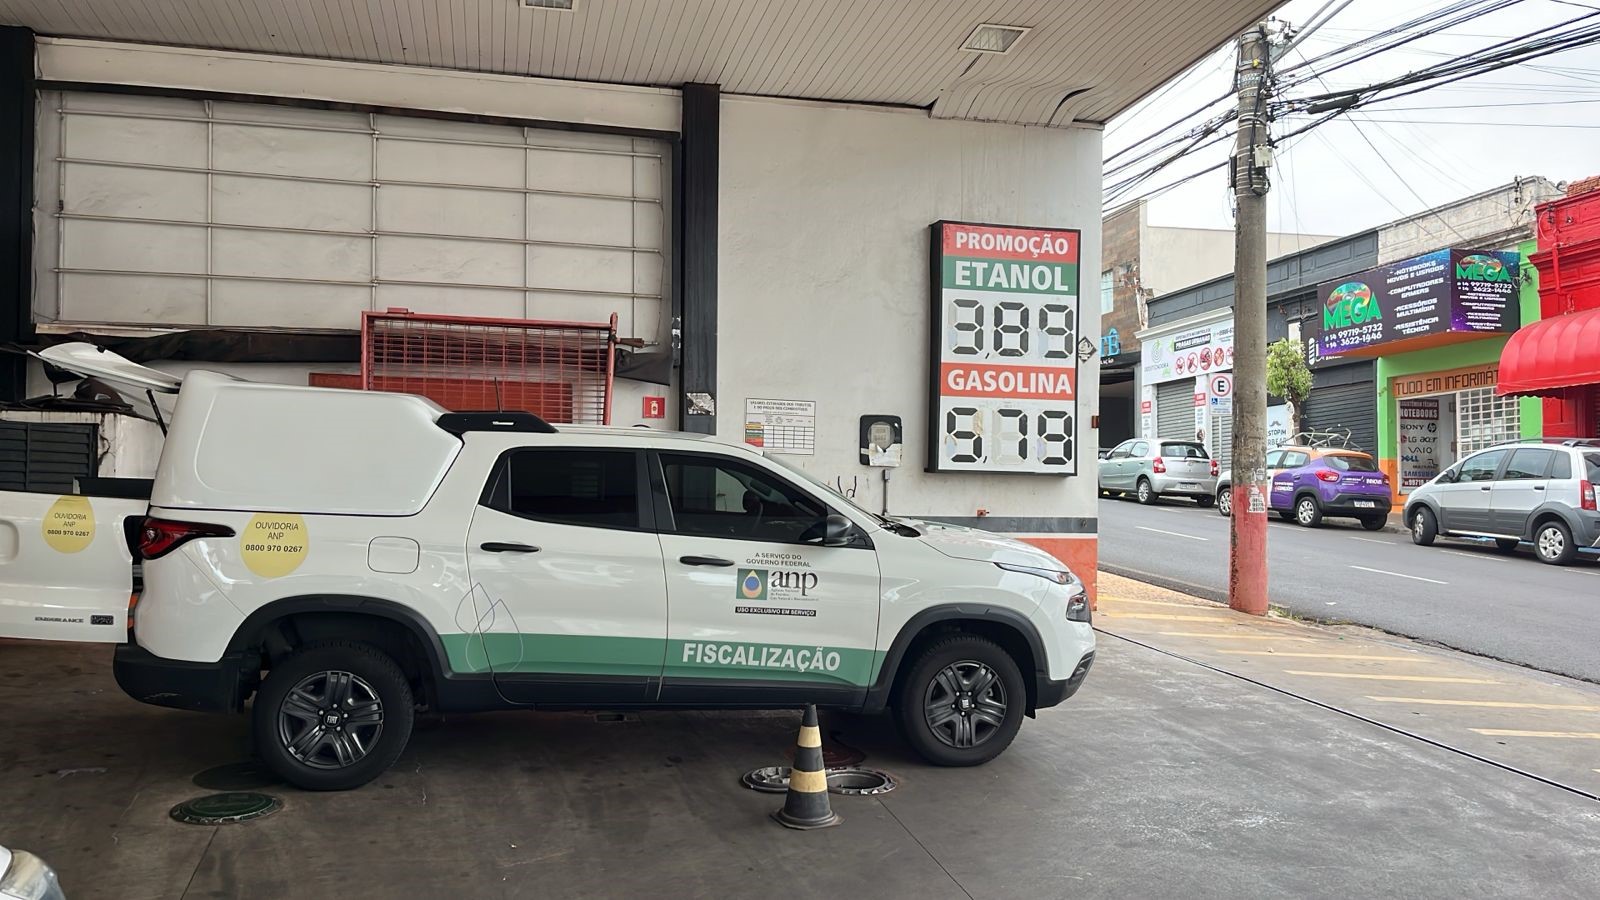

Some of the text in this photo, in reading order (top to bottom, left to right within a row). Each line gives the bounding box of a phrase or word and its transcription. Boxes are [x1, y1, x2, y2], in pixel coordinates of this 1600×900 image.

[956, 231, 1069, 258] PROMOÇÃO
[955, 260, 1069, 291] ETANOL
[1386, 274, 1409, 284] NOVOS
[1416, 264, 1445, 277] USADOS
[1456, 262, 1512, 282] MEGA
[1401, 287, 1430, 299] GAMERS
[1473, 286, 1512, 294] 3622-1446
[1323, 291, 1383, 331] MEGA
[951, 298, 1074, 359] 3,89
[1338, 323, 1383, 339] 99719-5732
[1402, 324, 1430, 335] TÉCNICA
[947, 369, 1073, 394] GASOLINA
[1217, 380, 1225, 392] E
[1395, 380, 1422, 394] TUDO
[1426, 378, 1441, 392] EM
[946, 407, 1073, 466] 5,79
[54, 512, 87, 520] OUVIDORIA
[256, 522, 299, 530] OUVIDORIA
[771, 570, 818, 596] anp
[682, 643, 840, 672] FISCALIZAÇÃO
[327, 716, 338, 724] FIAT
